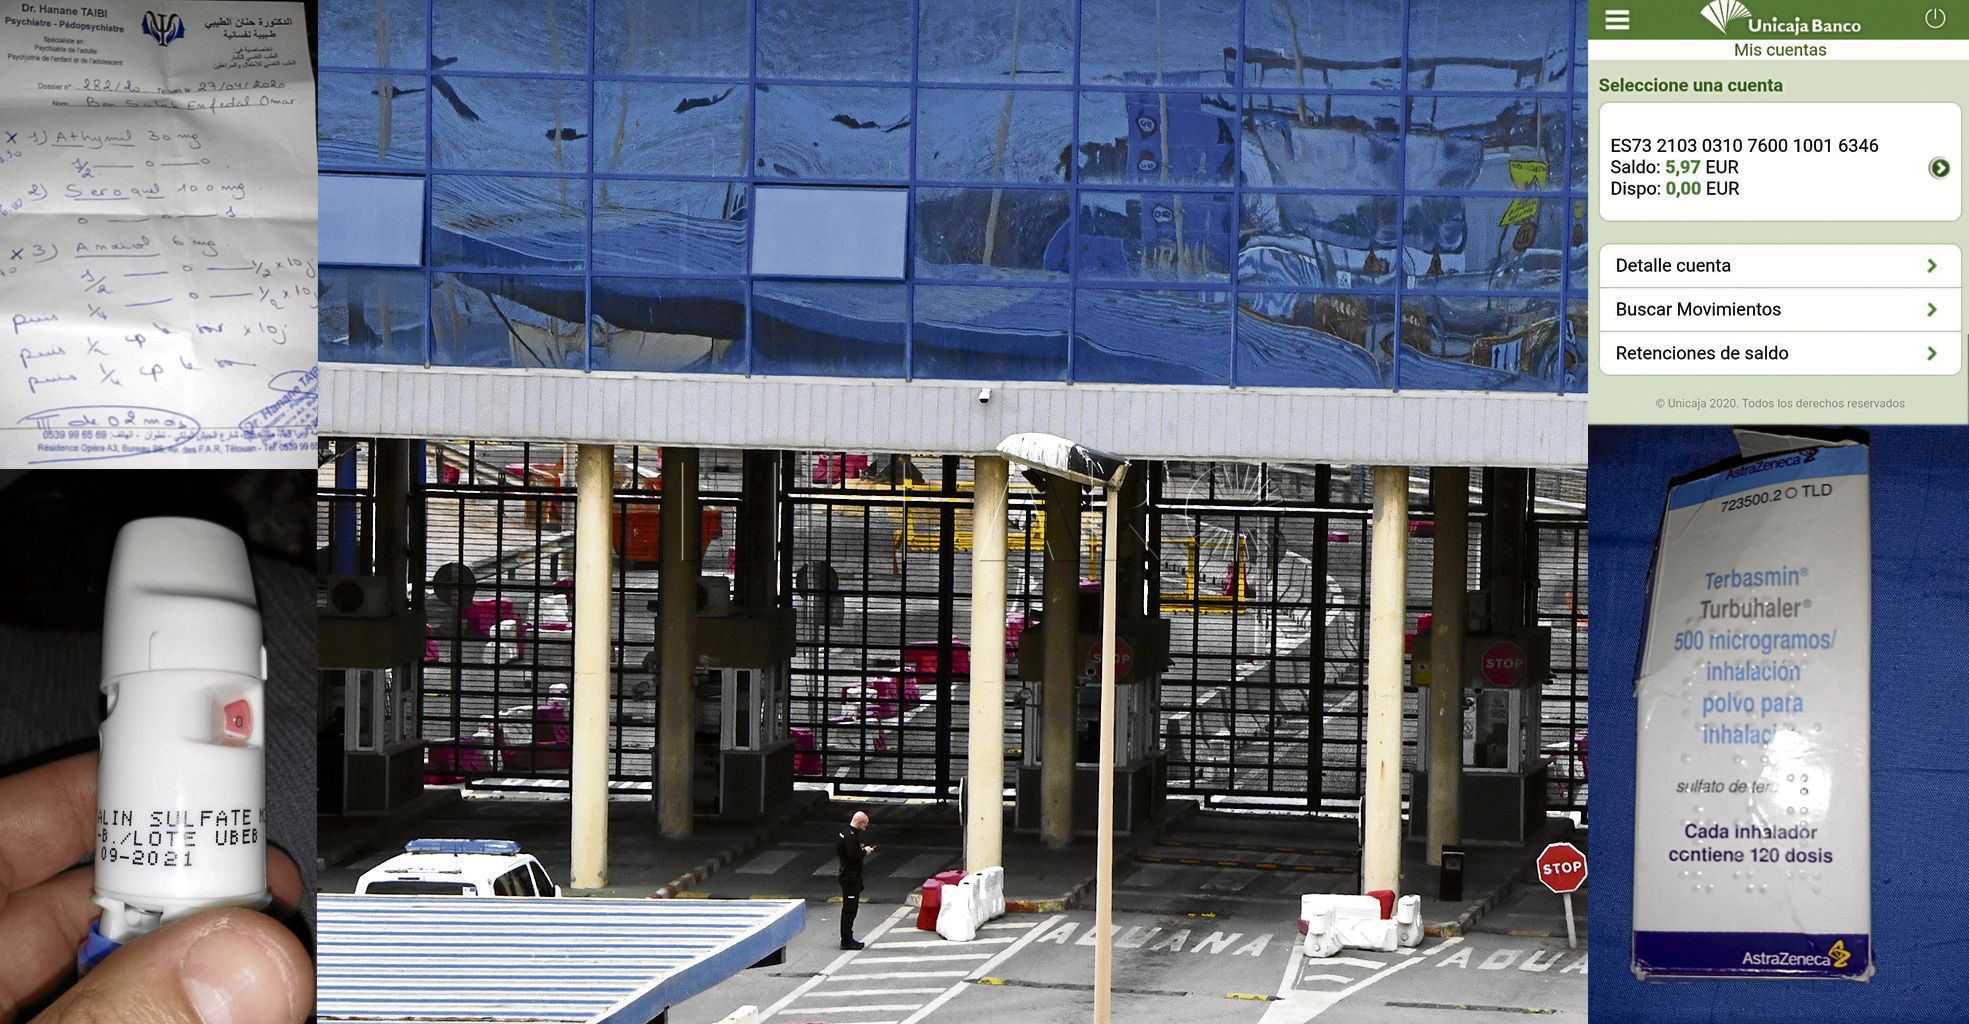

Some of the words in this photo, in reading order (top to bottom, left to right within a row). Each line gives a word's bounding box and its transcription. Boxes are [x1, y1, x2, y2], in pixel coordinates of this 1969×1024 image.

[21, 3, 36, 13] Dr.
[39, 4, 78, 16] Hanane
[81, 7, 108, 18] TAIBI
[5, 16, 52, 27] Psychiatre
[58, 20, 125, 33] Pédopsychiatre
[1748, 16, 1809, 36] Unicaja
[1812, 19, 1861, 32] Banco
[1735, 43, 1762, 57] Mis
[1766, 43, 1827, 57] cuentas
[1599, 77, 1689, 93] Seleccione
[1693, 80, 1724, 93] una
[1728, 78, 1784, 93] cuenta
[1611, 138, 1652, 153] ES73
[1656, 138, 1698, 153] 2103
[1702, 138, 1743, 153] 0310
[1747, 138, 1789, 153] 7600
[1793, 138, 1832, 153] 1001
[1838, 138, 1879, 153] 6346
[1611, 159, 1661, 175] Saldo:
[1665, 159, 1702, 176] 5,97
[1706, 160, 1739, 174] EUR
[1611, 181, 1661, 199] Dispo:
[1665, 181, 1702, 198] 0,00
[1706, 181, 1740, 195] EUR
[1617, 258, 1672, 273] Detalle
[1676, 259, 1731, 273] cuenta
[1617, 302, 1673, 317] Buscar
[1677, 302, 1782, 317] Movimientos
[1617, 346, 1716, 361] Retenciones
[1720, 345, 1740, 361] de
[1745, 345, 1789, 361] saldo
[1668, 398, 1706, 411] Unicaja
[1709, 398, 1739, 409] 2020.
[1742, 398, 1774, 409] Todos
[1777, 398, 1793, 409] los
[1796, 398, 1845, 409] derechos
[1847, 398, 1905, 409] reservados
[42, 430, 66, 439] 0539
[68, 430, 80, 439] 99
[37, 443, 80, 451] Résidence
[1725, 455, 1801, 480] AstraZeneca
[1721, 489, 1782, 513] 723500.2
[1801, 483, 1832, 497] TLD
[1674, 630, 1704, 651] 500
[1709, 628, 1837, 655] microgramos/
[1485, 658, 1523, 669] STOP
[1706, 660, 1801, 681] inhalación
[1702, 692, 1755, 718] polvo
[1761, 695, 1804, 718] para
[1676, 779, 1725, 793] sulfato
[1728, 780, 1747, 793] de
[215, 828, 258, 846] UBEB
[1685, 823, 1729, 839] Cada
[1735, 824, 1818, 840] inhalador
[100, 848, 192, 867] 09-2021
[1669, 847, 1745, 863] contiene
[1751, 847, 1780, 863] 120
[1785, 848, 1833, 863] dosis
[1543, 861, 1582, 876] STOP
[1742, 952, 1831, 967] AstraZeneca
